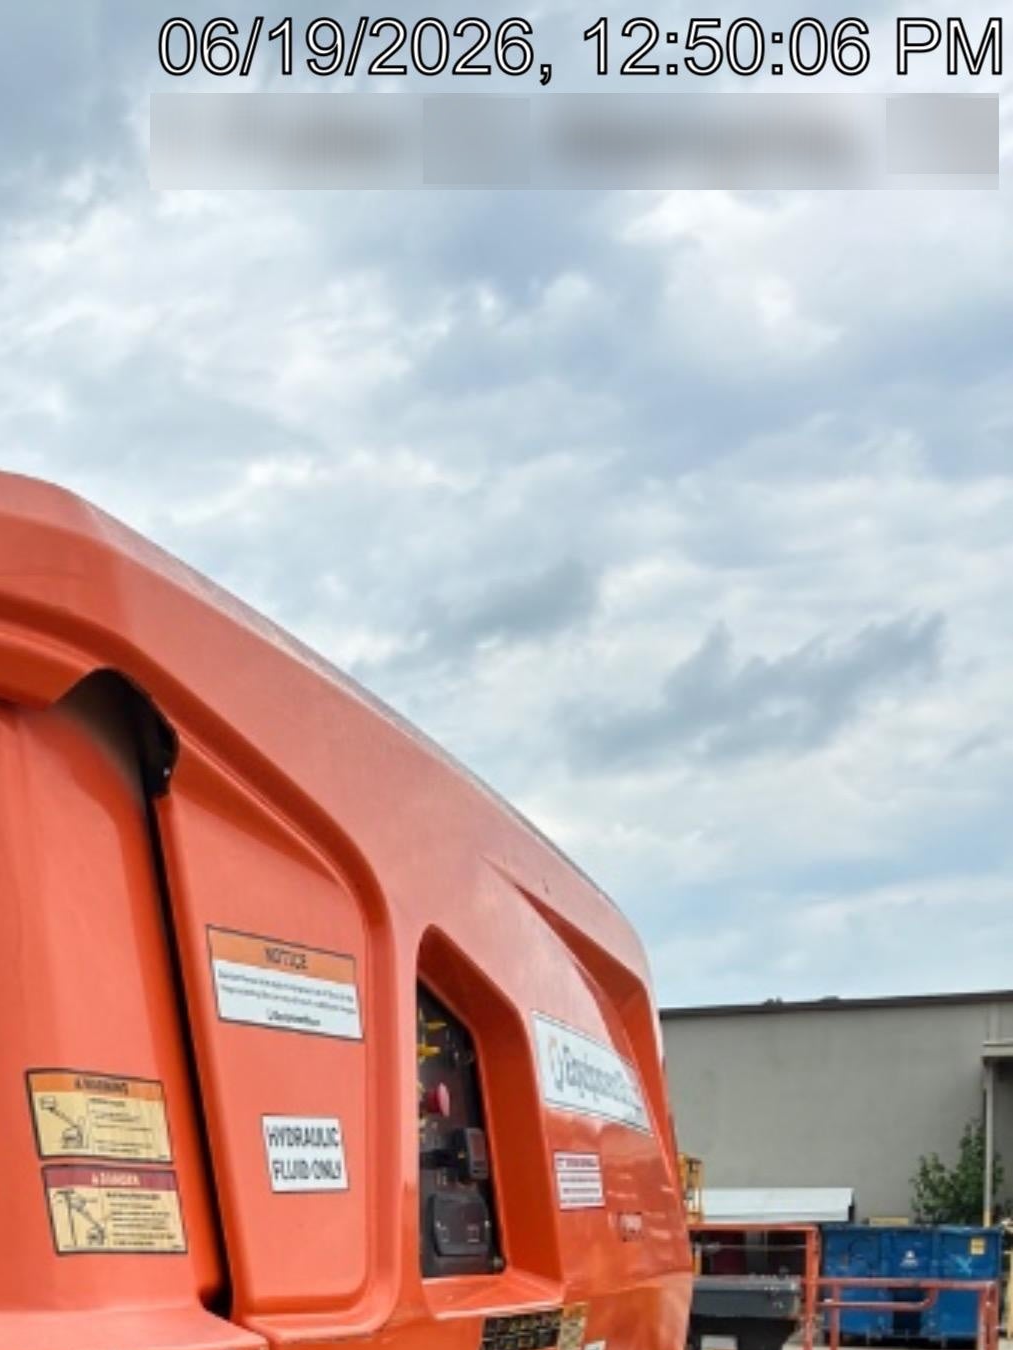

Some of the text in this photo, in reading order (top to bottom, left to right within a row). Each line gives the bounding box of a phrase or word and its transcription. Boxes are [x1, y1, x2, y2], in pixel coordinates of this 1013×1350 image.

[266, 1125, 339, 1147] HYDRAULIC
[272, 1160, 341, 1180] FLUID ONLY
